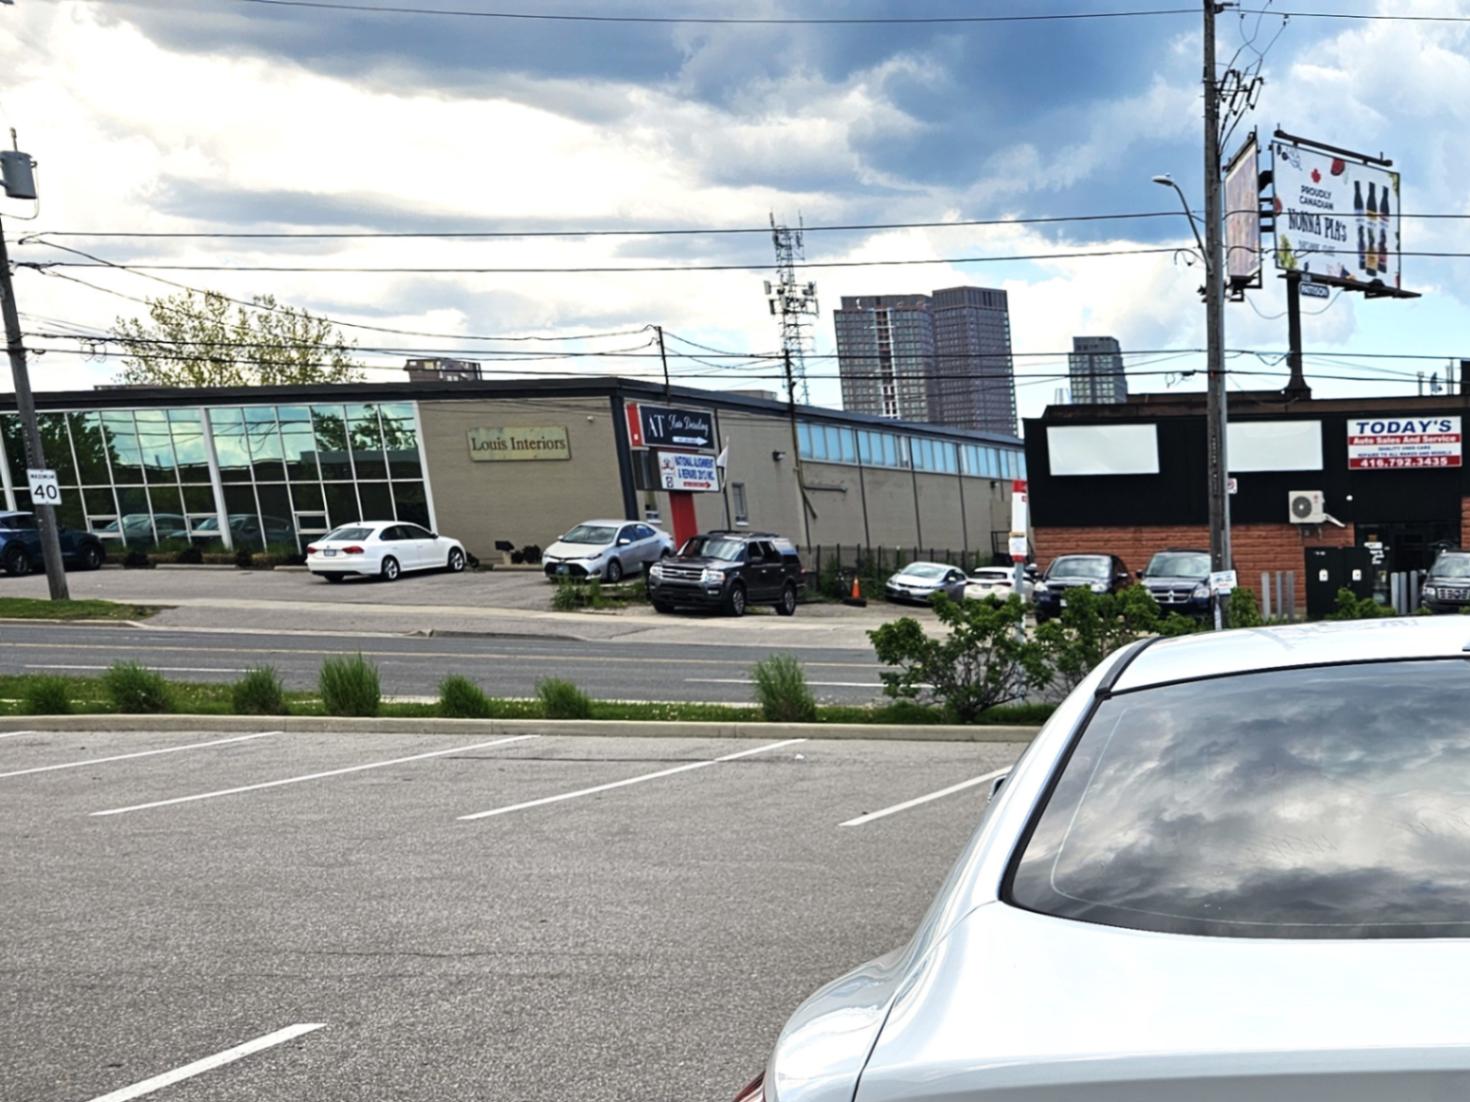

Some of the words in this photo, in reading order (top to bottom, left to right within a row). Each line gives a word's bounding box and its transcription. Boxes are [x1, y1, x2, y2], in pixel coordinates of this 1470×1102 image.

[1301, 185, 1331, 199] PROUDLY
[1299, 195, 1334, 210] CANADIAN
[648, 415, 665, 437] AT
[1356, 419, 1452, 434] TODAY'S
[471, 436, 508, 451] Louis
[510, 436, 566, 450] Interiors
[1353, 436, 1374, 444] Auto
[1376, 435, 1401, 444] Sales
[1403, 435, 1420, 443] And
[1422, 434, 1457, 442] Service
[1360, 457, 1448, 467] 416.792.3435
[34, 484, 57, 499] 40
